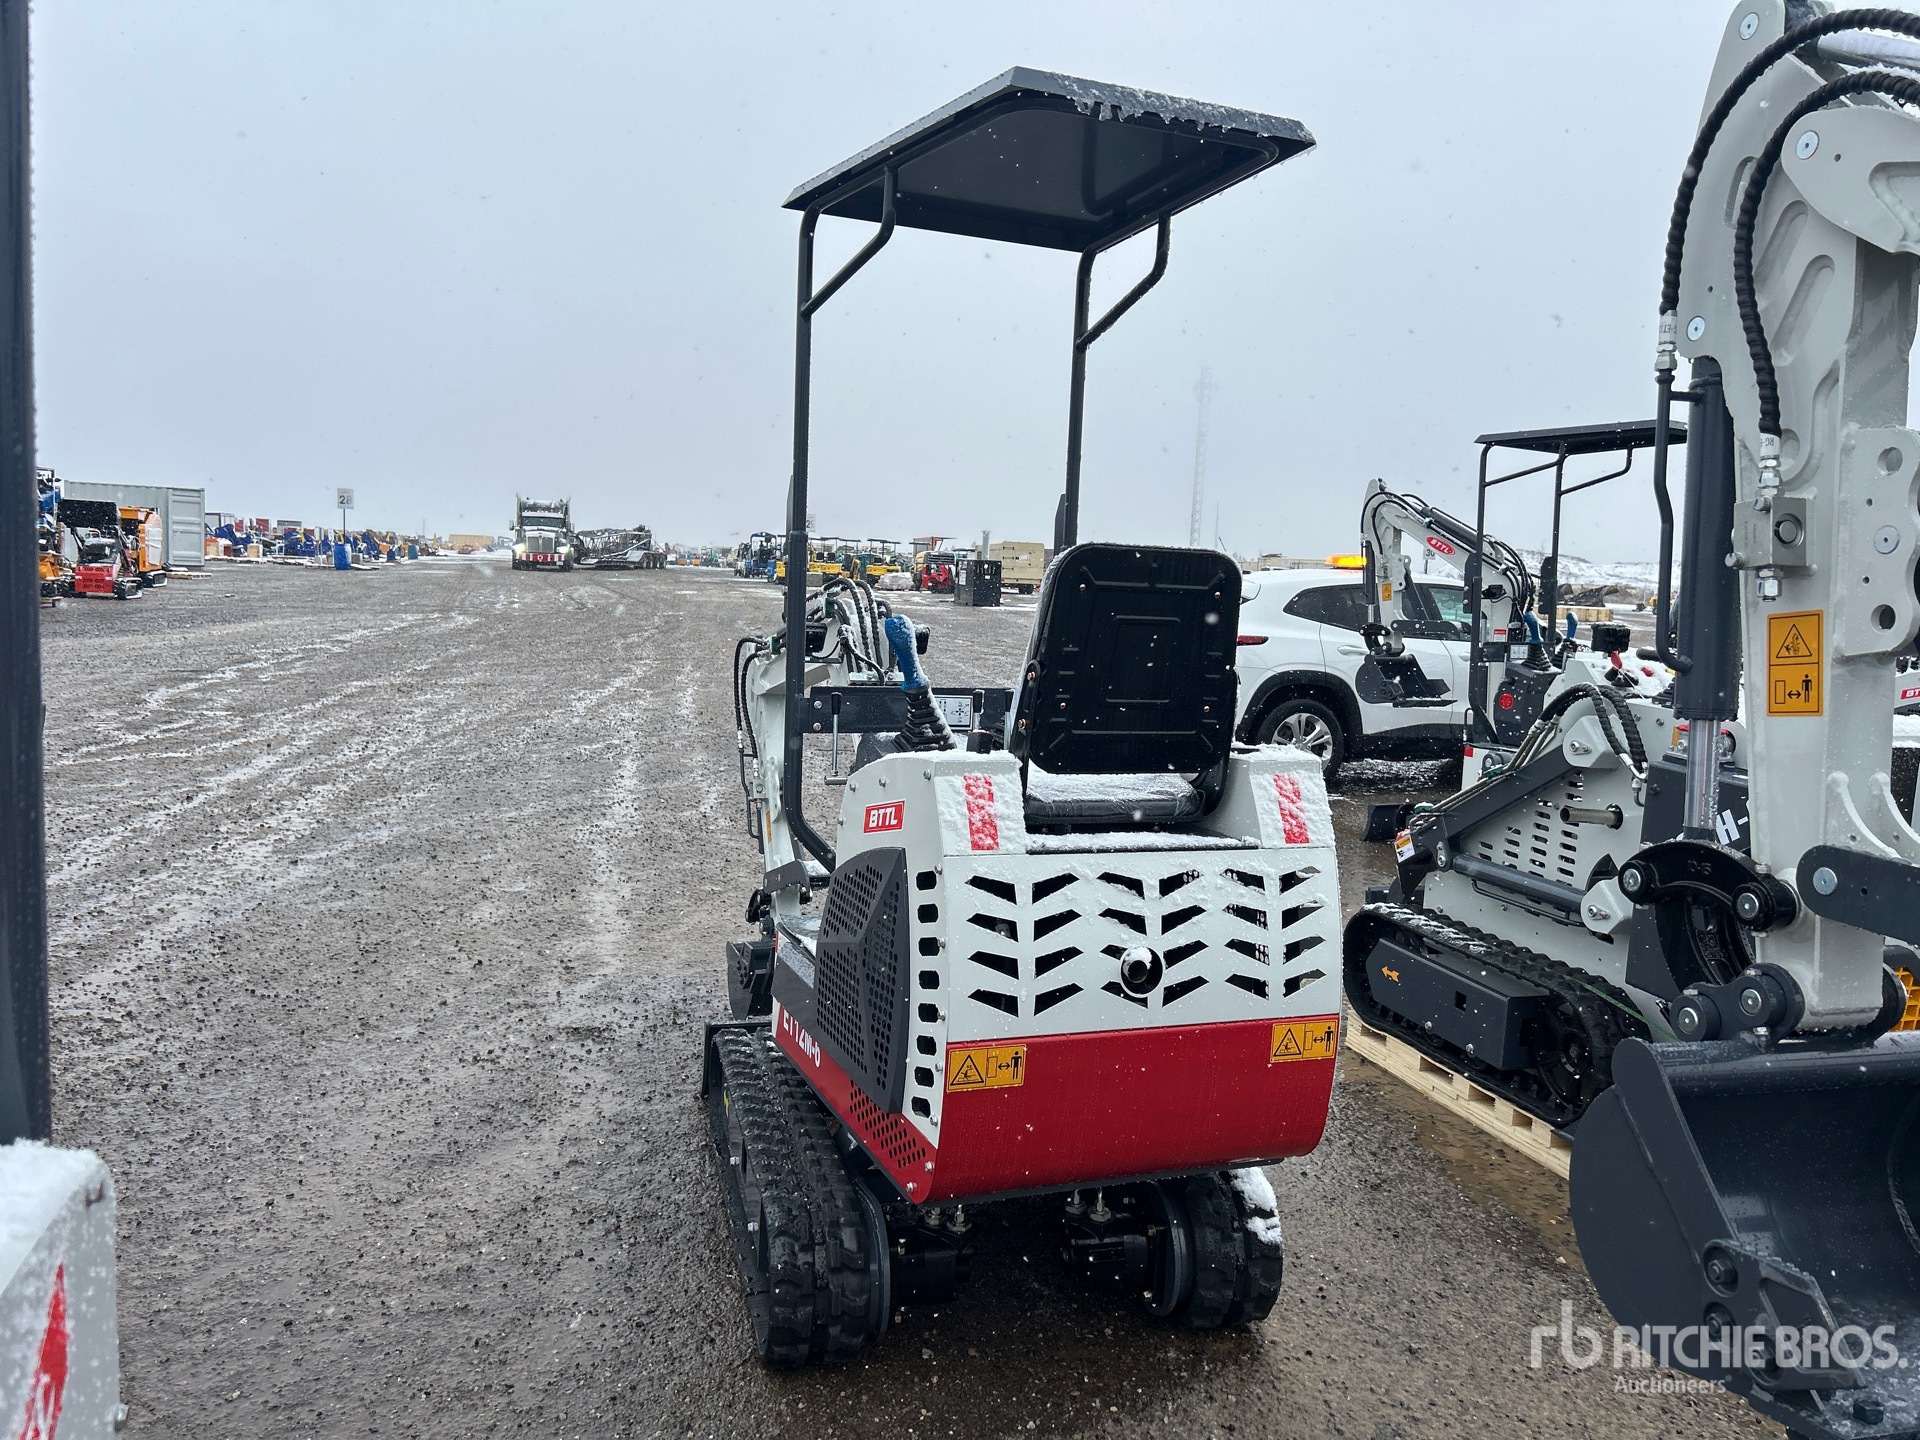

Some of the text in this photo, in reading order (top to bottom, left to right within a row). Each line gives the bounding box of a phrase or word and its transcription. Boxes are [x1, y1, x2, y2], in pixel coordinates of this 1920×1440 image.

[339, 494, 352, 505] 28
[1430, 538, 1449, 554] BTTL
[869, 806, 898, 828] BTTL
